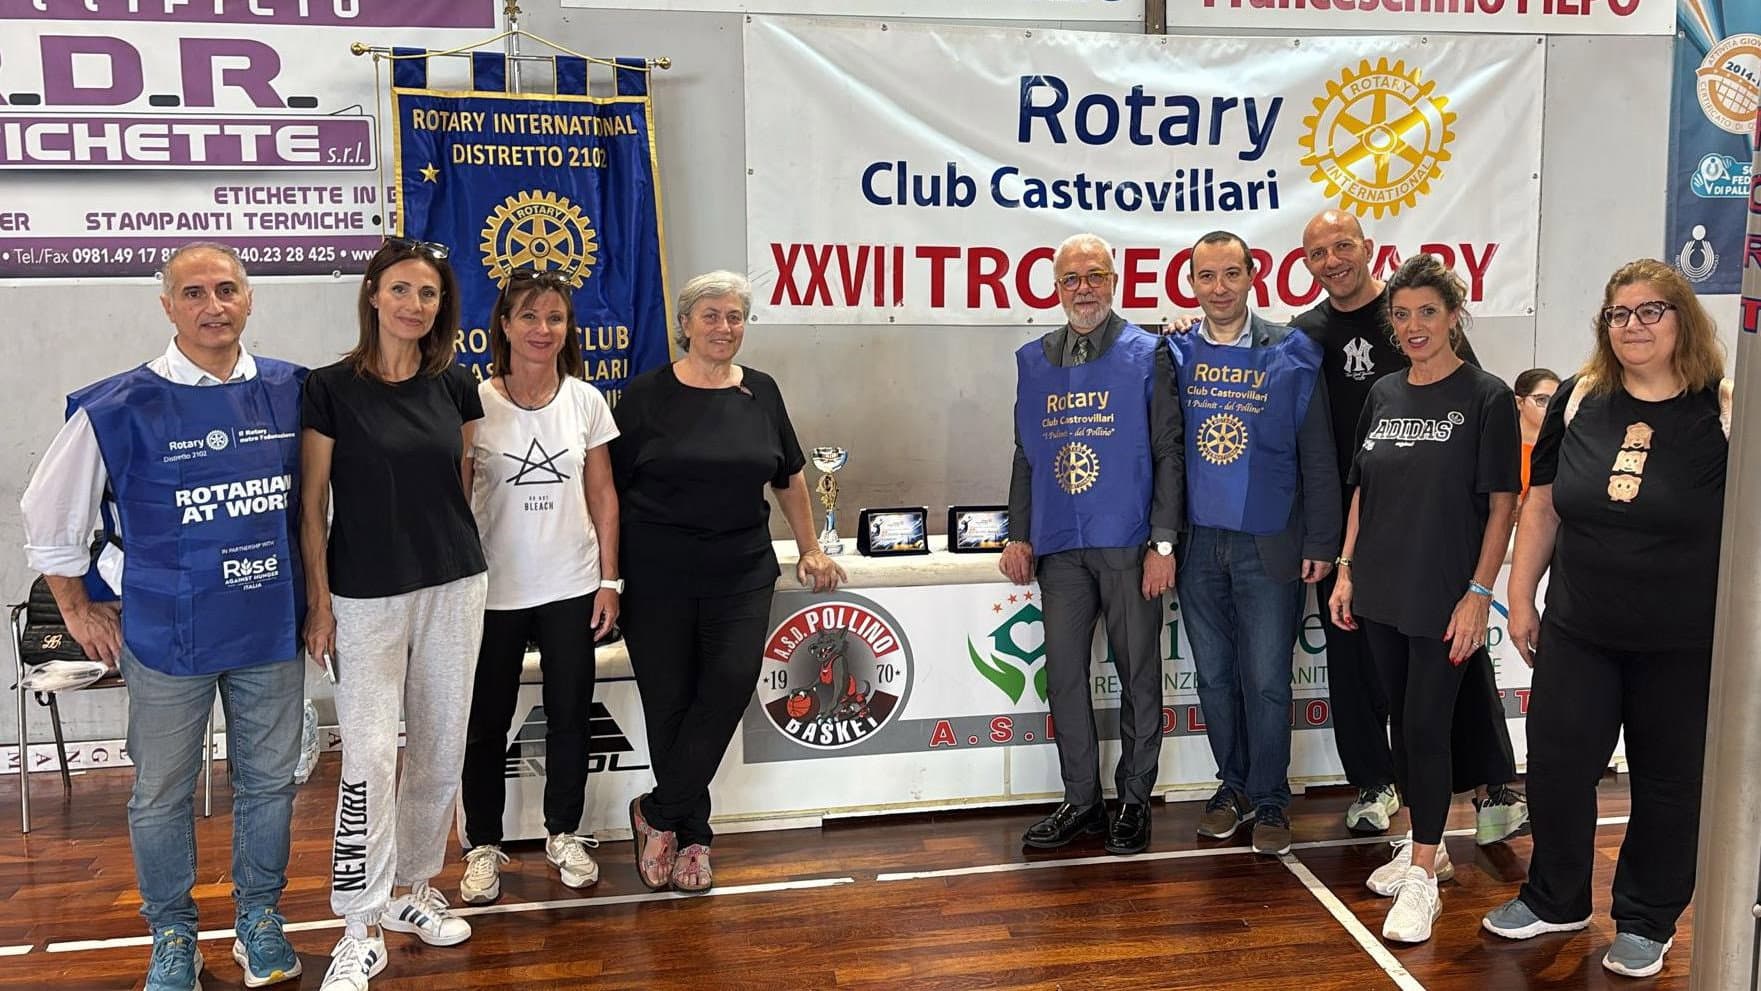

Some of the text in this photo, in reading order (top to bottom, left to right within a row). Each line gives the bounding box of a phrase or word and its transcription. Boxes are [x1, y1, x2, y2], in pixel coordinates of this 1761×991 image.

[0, 35, 319, 108] .D.R.
[1350, 76, 1412, 95] ROTARY
[412, 108, 638, 137] ROTARY INTERNATIONAL
[1018, 75, 1284, 161] Rotary
[326, 142, 366, 164] s.r.l.
[452, 143, 608, 169] DISTRETTO 2102
[861, 160, 1280, 212] Club Castrovillari
[1326, 158, 1432, 201] INTERNATIONAL
[214, 186, 343, 205] ETICHETTE
[353, 186, 377, 204] IN
[85, 212, 364, 232] STAMPANTI TERMICHE
[518, 205, 563, 219] ROTARY
[14, 248, 70, 264] Tel./Fax
[72, 248, 133, 264] 0981.49
[138, 249, 157, 264] 17
[286, 248, 304, 262] 28
[308, 247, 336, 262] 425
[770, 243, 1499, 310] XXVII TROEO ROAY
[1195, 363, 1266, 389] Rotary
[1046, 391, 1110, 414] Rotary
[1187, 385, 1269, 402] Club Castrovillari
[1060, 413, 1115, 426] Castrovillari
[1369, 418, 1453, 442] ADIDAS
[169, 439, 204, 451] Rotary
[182, 504, 219, 525] AT
[524, 502, 554, 511] BLEACH
[773, 607, 895, 660] A.S.D. POLLINO
[771, 670, 788, 690] 19
[876, 664, 894, 684] 70
[333, 777, 368, 892] NEW YORK
